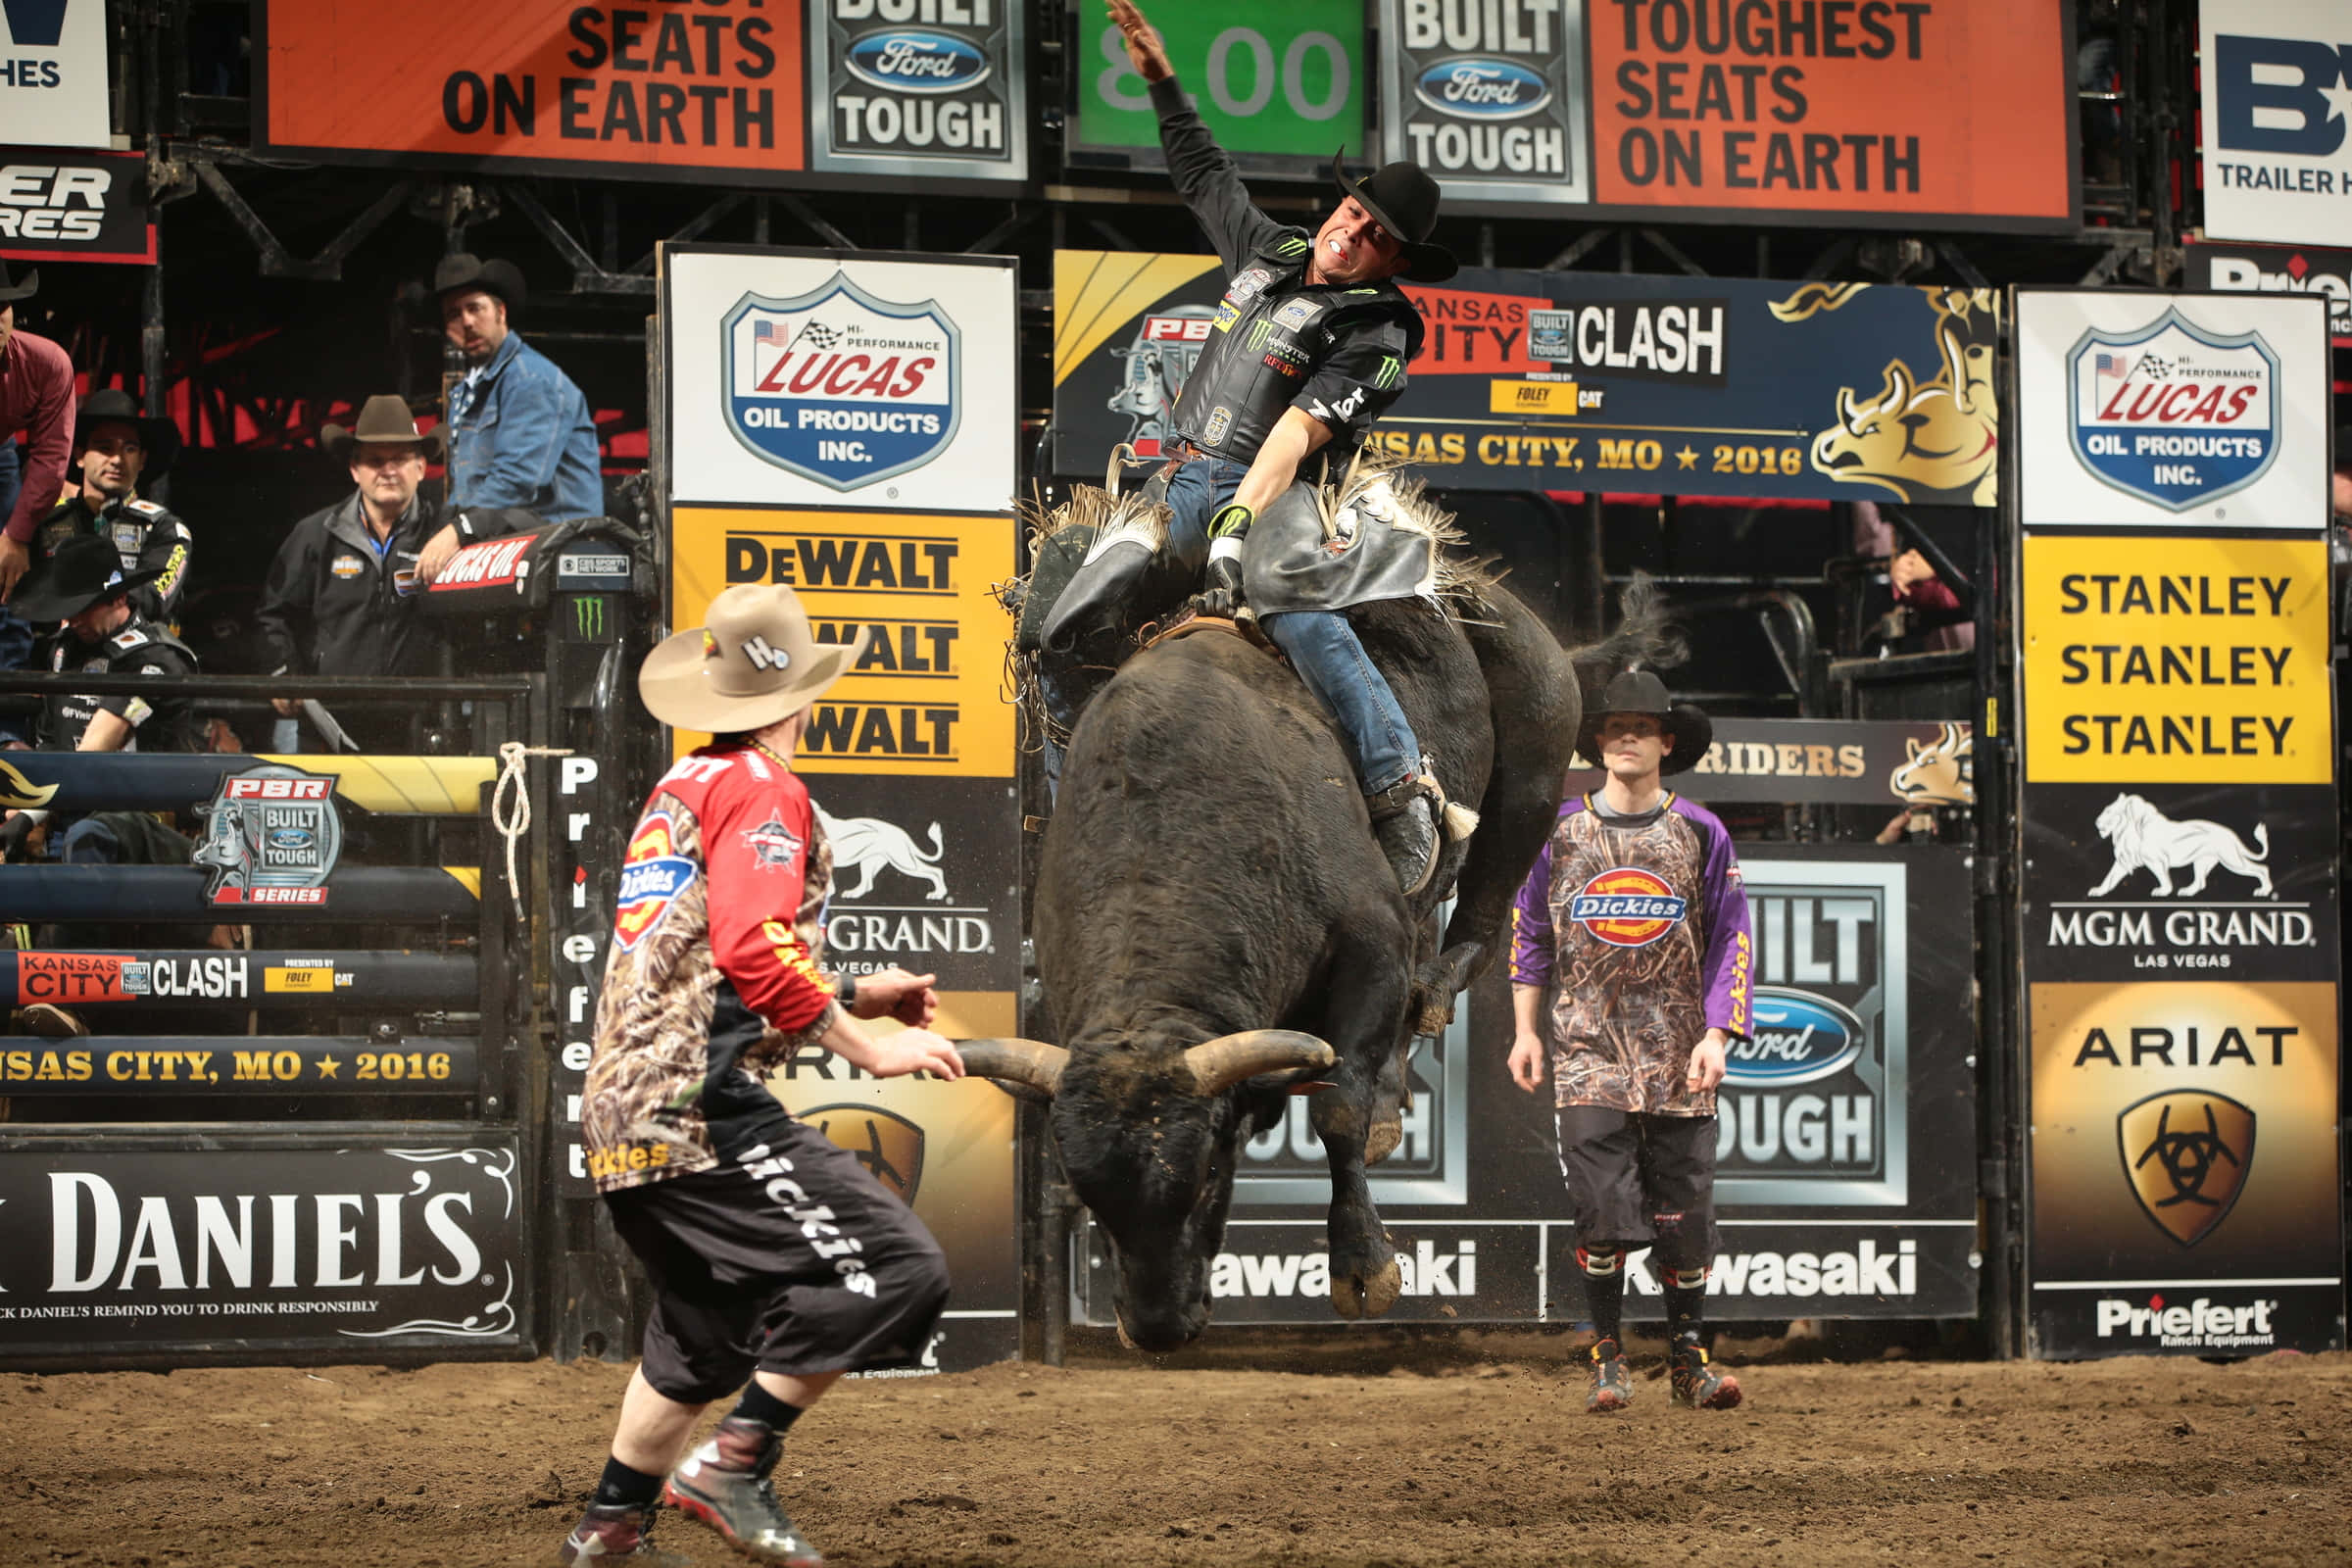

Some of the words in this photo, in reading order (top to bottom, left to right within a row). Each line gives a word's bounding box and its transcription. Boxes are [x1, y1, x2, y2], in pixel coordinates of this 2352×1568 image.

[567, 6, 776, 79] SEATS
[1404, 0, 1559, 54] BUILT
[1610, 0, 1932, 61] TOUGHEST
[876, 40, 957, 78] Ford
[1443, 63, 1520, 105] Ford
[1616, 60, 1808, 123] SEATS
[443, 71, 536, 136] ON
[560, 76, 775, 149] EARTH
[837, 97, 1004, 149] TOUGH
[1407, 122, 1565, 174] TOUGH
[1618, 127, 1703, 188] ON
[1723, 131, 1922, 194] EARTH
[2218, 164, 2334, 195] TRAILER
[1414, 297, 1525, 323] ANSAS
[1533, 316, 1568, 329] BUILT
[847, 338, 941, 351] PERFORMANCE
[1146, 319, 1213, 340] PB
[1413, 324, 1522, 362] ITY
[1578, 306, 1725, 374] CLASH
[755, 352, 937, 398] LUCAS
[2179, 368, 2262, 379] PERFORMANCE
[1516, 386, 1551, 401] FOLEY
[1578, 390, 1604, 408] CAT
[2096, 383, 2258, 423] LUCAS
[743, 407, 790, 428] OIL
[798, 410, 941, 434] PRODUCTS
[818, 441, 873, 463] INC.
[1364, 431, 1466, 464] NSAS
[1477, 435, 1584, 472] CITY,
[1597, 440, 1663, 470] MO
[1712, 445, 1802, 475] 2016
[2087, 435, 2129, 456] OIL
[2135, 436, 2263, 458] PRODUCTS
[2153, 466, 2203, 485] INC.
[2060, 574, 2291, 616] STANLEY
[2061, 644, 2292, 686] STANLEY
[803, 707, 958, 755] WALT
[2062, 715, 2294, 756] STANLEY
[1693, 742, 1865, 777] RIDERS
[230, 780, 325, 798] PBR
[267, 809, 317, 828] BUILT
[267, 850, 317, 863] TOUGH
[253, 889, 321, 902] SERIES
[1577, 897, 1680, 918] Dickies
[826, 915, 990, 954] GRAND
[1743, 897, 1875, 984] ILT
[2047, 911, 2154, 947] MGM
[2165, 911, 2313, 947] GRAND
[24, 956, 119, 972] KANSAS
[153, 956, 248, 999] CLASH
[285, 971, 313, 982] FOLEY
[334, 973, 355, 986] CAT
[2134, 955, 2169, 968] LAS
[2174, 955, 2231, 968] VEGAS
[25, 972, 118, 998] CITY
[1729, 931, 1751, 1036] ickies
[2073, 1027, 2299, 1066] ARIAT
[0, 1051, 93, 1081] SAS
[106, 1051, 219, 1084] CITY,
[232, 1051, 303, 1081] MO
[356, 1053, 451, 1080] 2016
[1716, 1094, 1873, 1163] OUGH
[47, 1170, 482, 1294] DANIEL'S
[1623, 1239, 1917, 1297] Kwasaki
[20, 1306, 90, 1318] DANIEL'S
[94, 1304, 159, 1317] REMIND
[161, 1304, 194, 1316] YOU
[197, 1303, 220, 1315] TO
[222, 1302, 274, 1315] DRINK
[277, 1300, 379, 1314] RESPONSIBLY
[2097, 1295, 2273, 1338] Priefert
[2161, 1335, 2202, 1347] Ranch
[2205, 1334, 2275, 1348] Equipment
